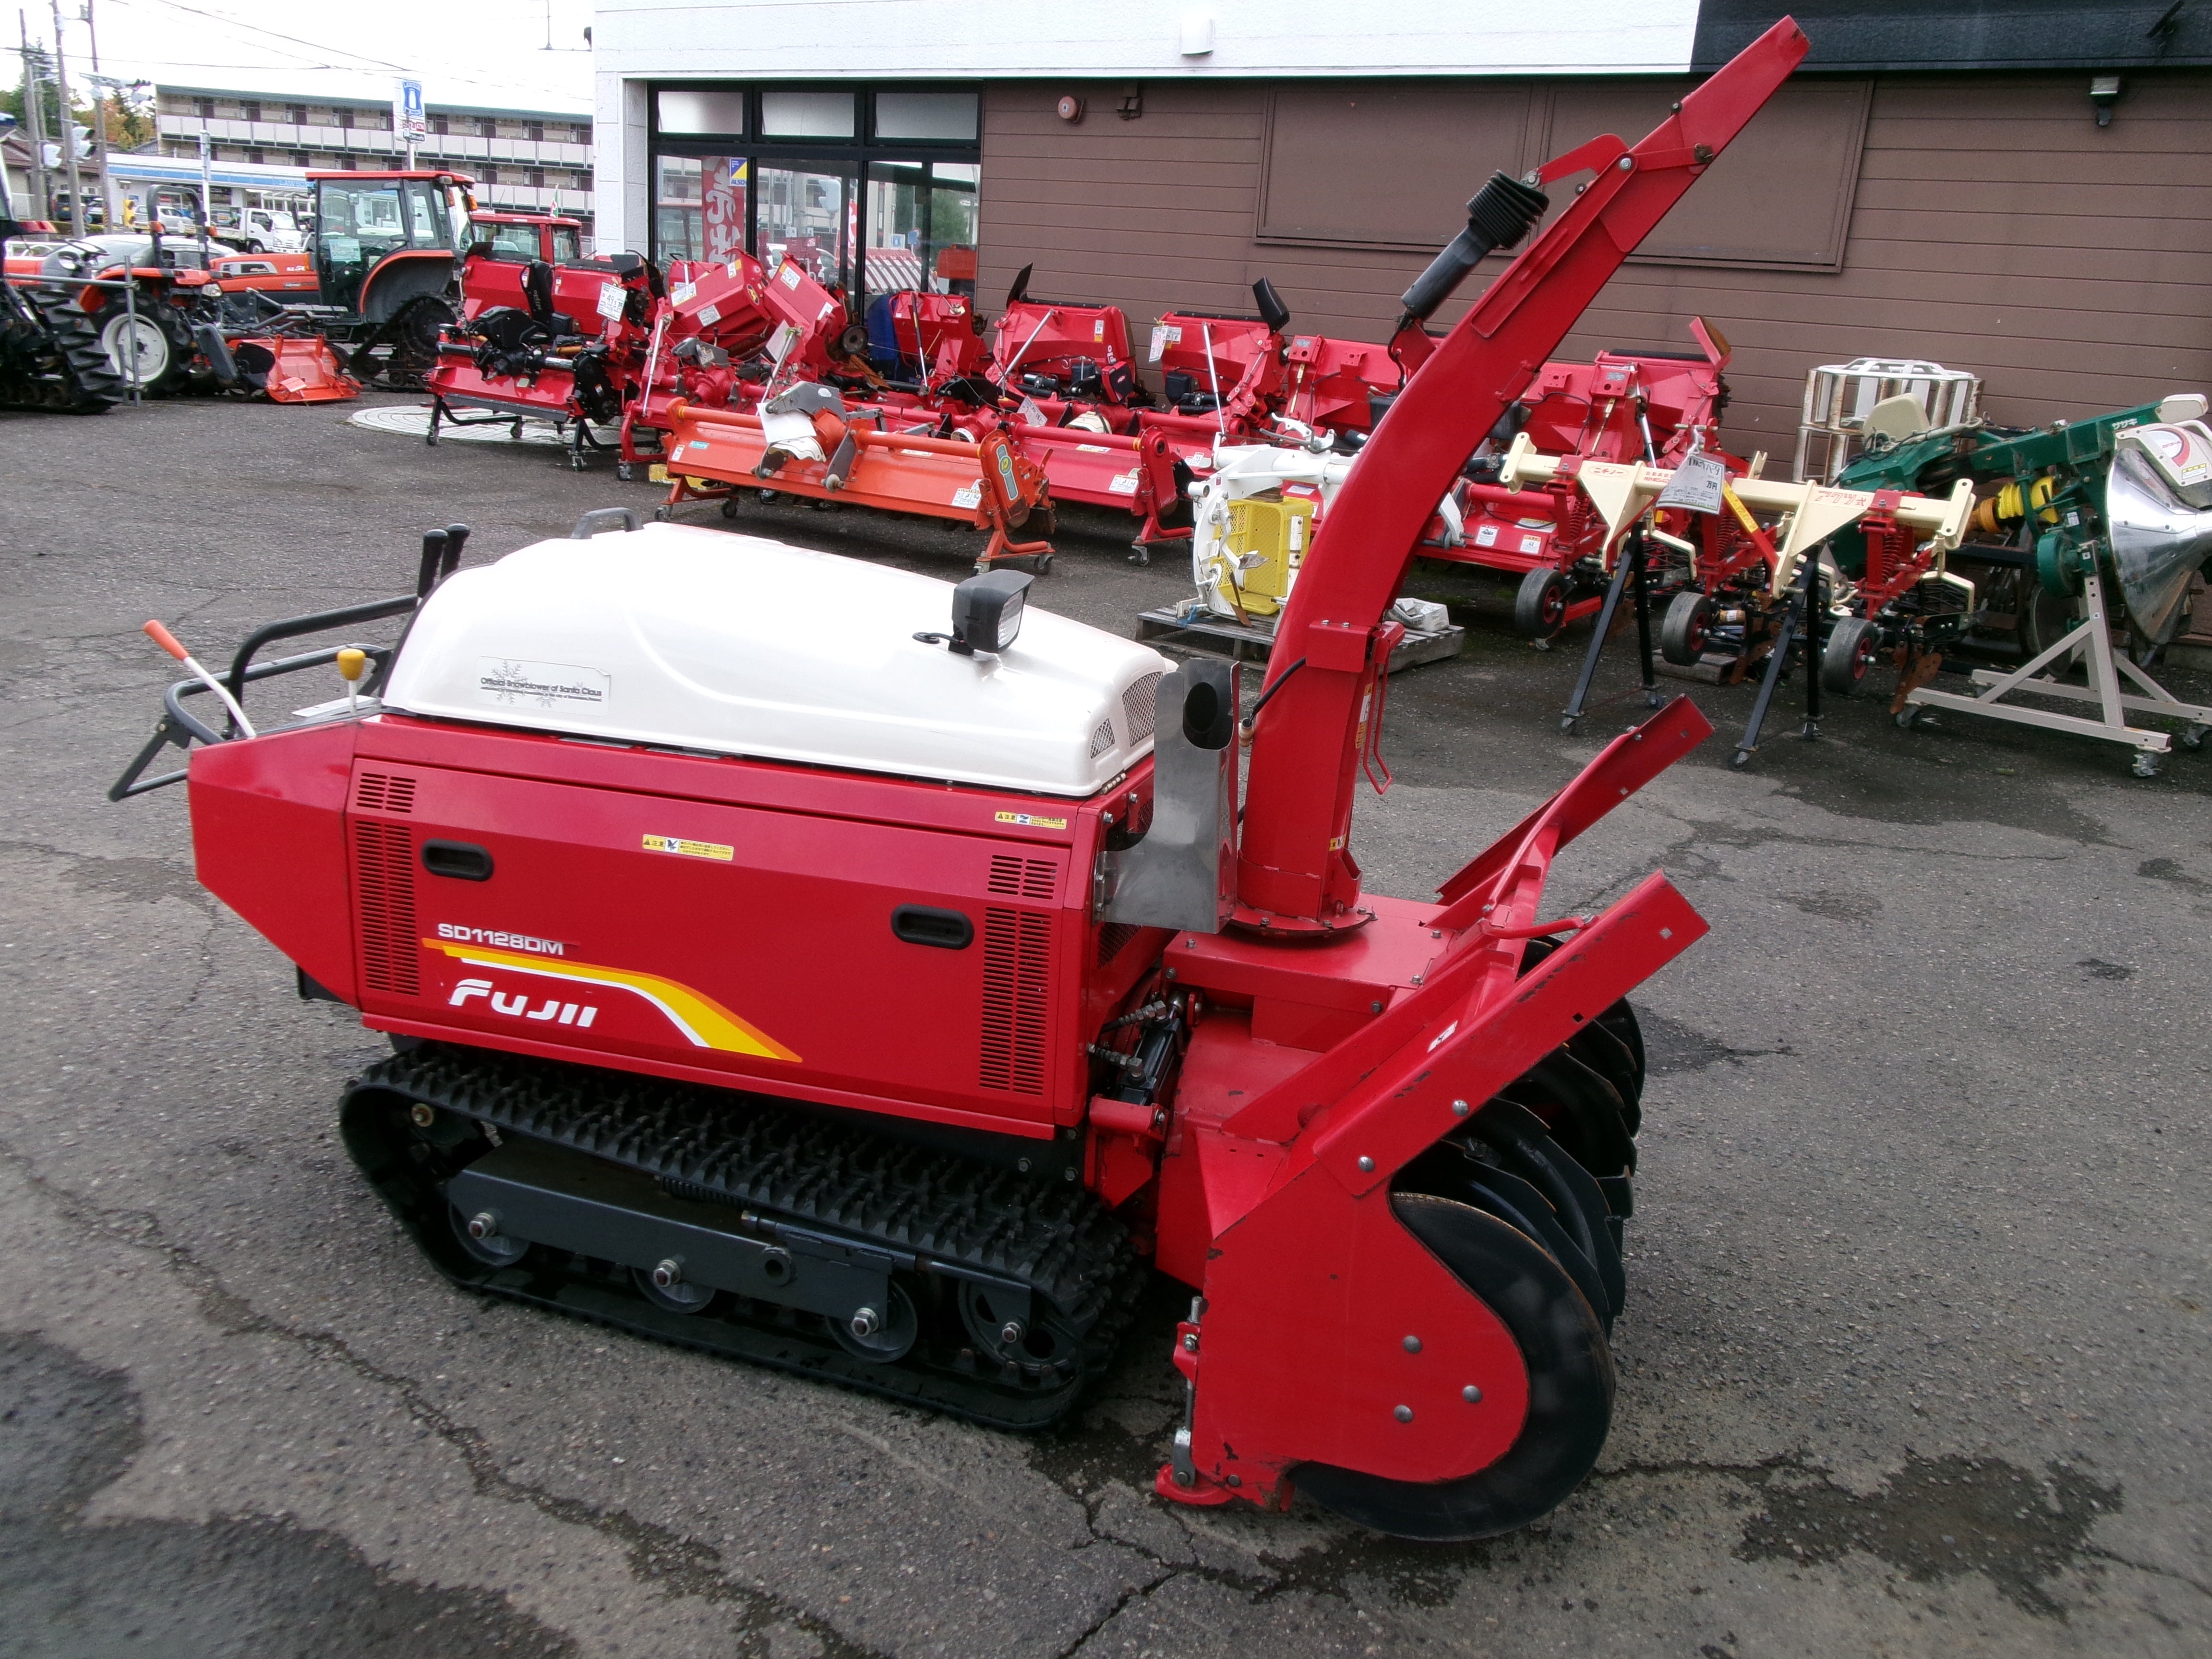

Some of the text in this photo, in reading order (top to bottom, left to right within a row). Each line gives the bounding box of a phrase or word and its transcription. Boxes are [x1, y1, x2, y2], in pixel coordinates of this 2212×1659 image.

[1706, 481, 1718, 491] 万円
[481, 677, 505, 686] Official
[507, 680, 550, 690] Snowblower
[559, 685, 580, 694] Santa
[581, 688, 602, 697] Claus
[438, 923, 565, 955] SD1128DM
